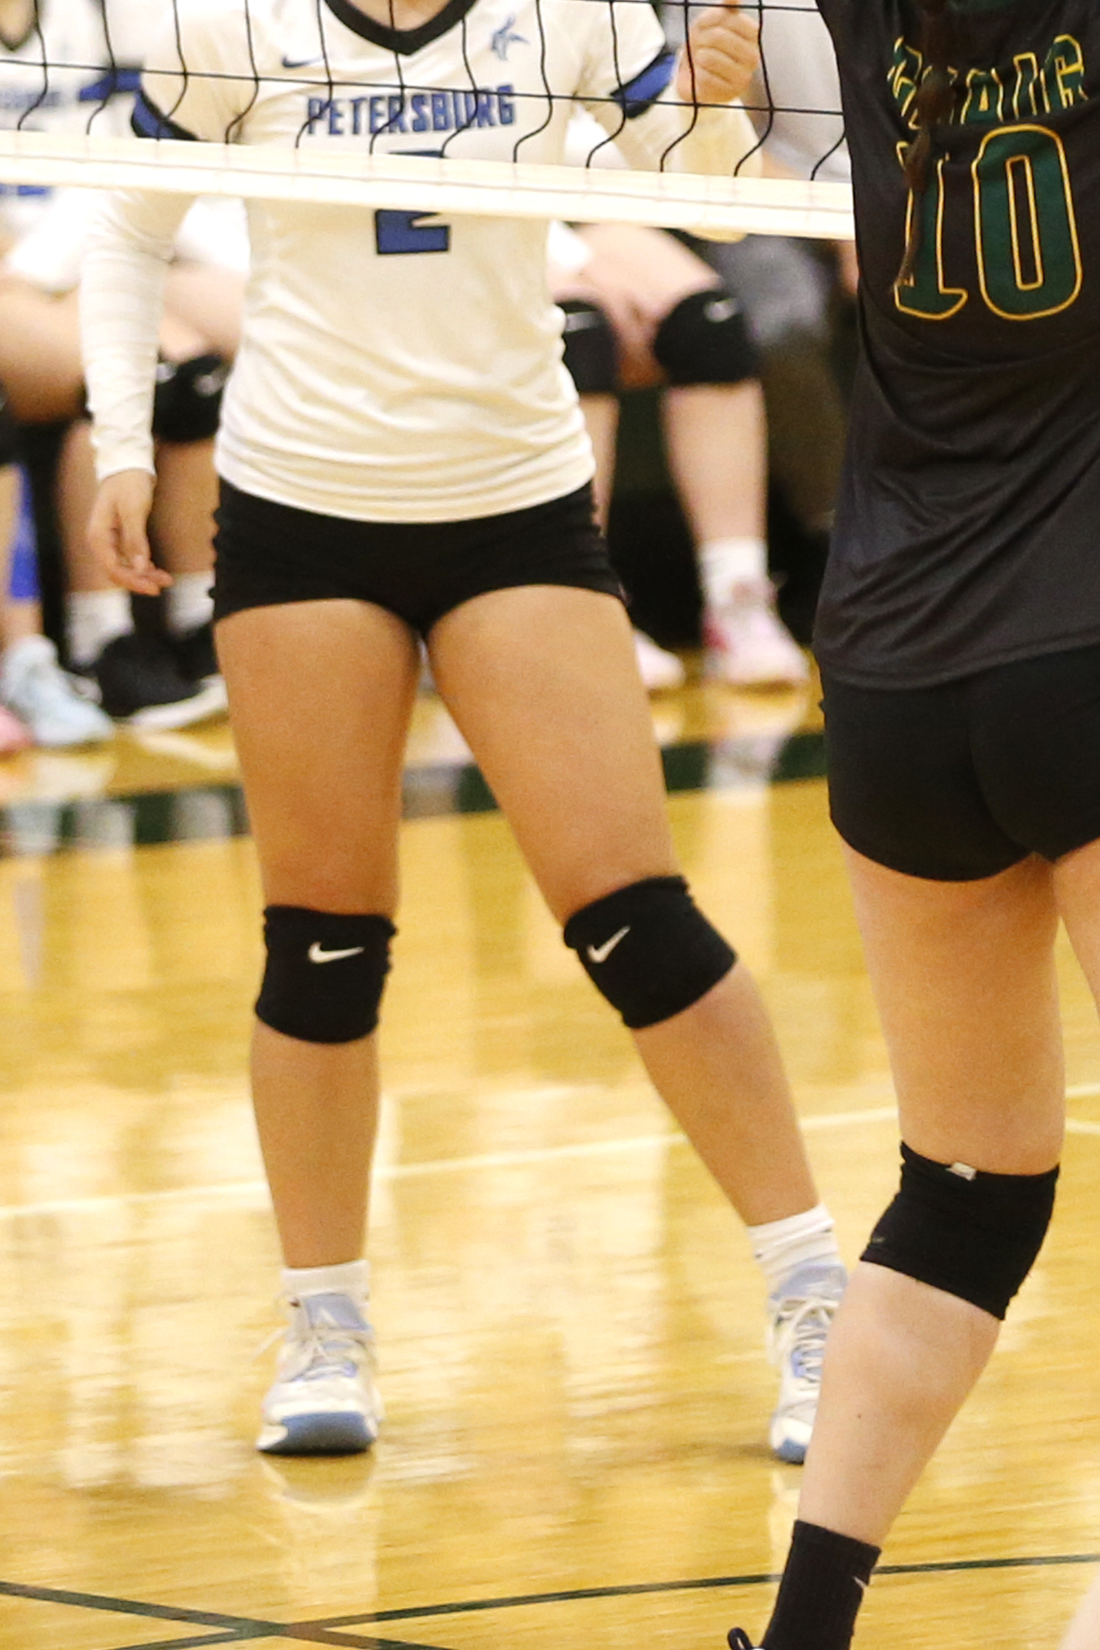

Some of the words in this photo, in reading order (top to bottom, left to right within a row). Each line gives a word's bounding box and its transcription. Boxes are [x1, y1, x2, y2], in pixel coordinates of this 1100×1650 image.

[306, 83, 515, 136] PETERSBURG
[887, 34, 1088, 128] CAIG
[893, 123, 1083, 320] 10
